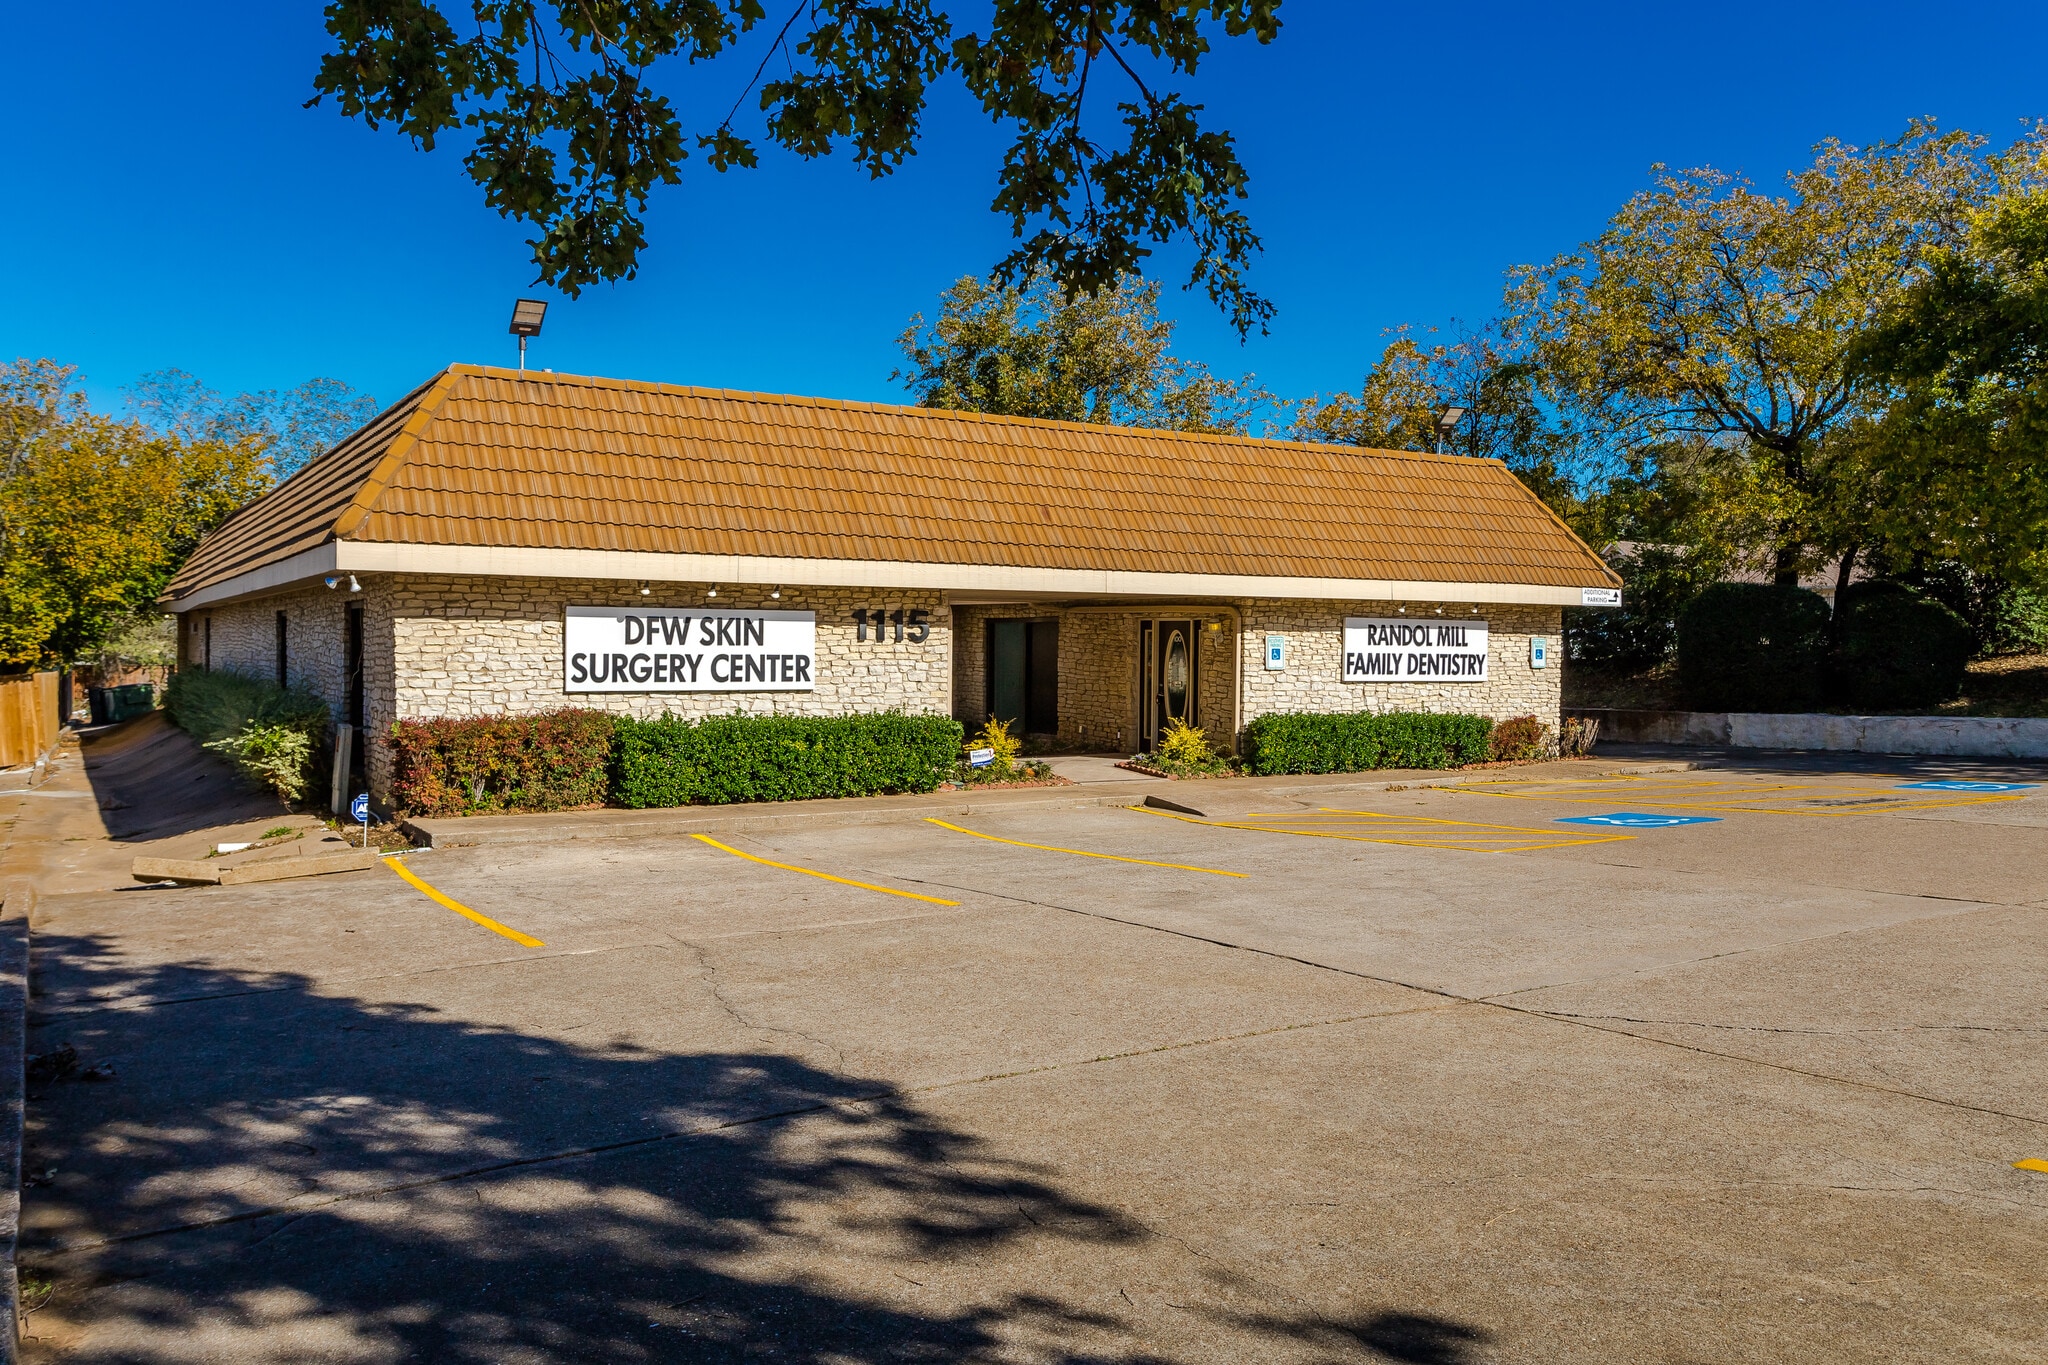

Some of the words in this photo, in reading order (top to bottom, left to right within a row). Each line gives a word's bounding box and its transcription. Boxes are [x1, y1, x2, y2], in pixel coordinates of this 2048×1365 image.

[624, 615, 690, 646] DFW
[700, 617, 764, 647] SKIN
[851, 608, 930, 644] 1115
[1367, 624, 1433, 647] RANDOL
[1437, 625, 1468, 647] MILL
[571, 652, 704, 684] SURGERY
[710, 653, 811, 683] CENTER
[1346, 653, 1403, 675] FAMILY
[1407, 653, 1486, 676] DENTISTRY
